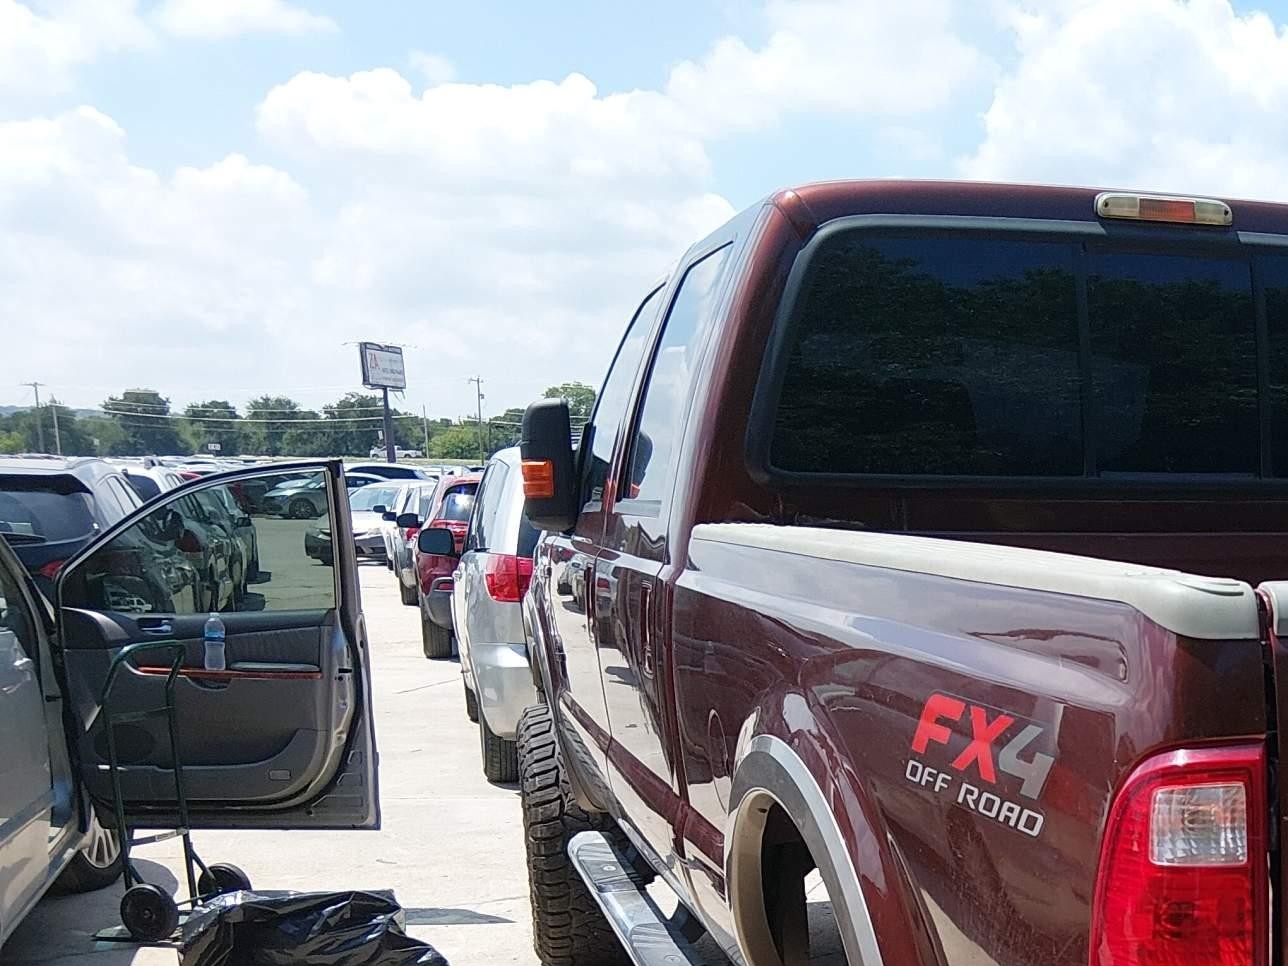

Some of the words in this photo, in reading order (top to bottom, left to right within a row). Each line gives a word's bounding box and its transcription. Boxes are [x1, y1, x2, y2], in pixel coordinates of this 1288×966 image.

[911, 693, 1055, 800] FX4
[905, 760, 952, 792] OFF
[957, 783, 1044, 837] ROAD
